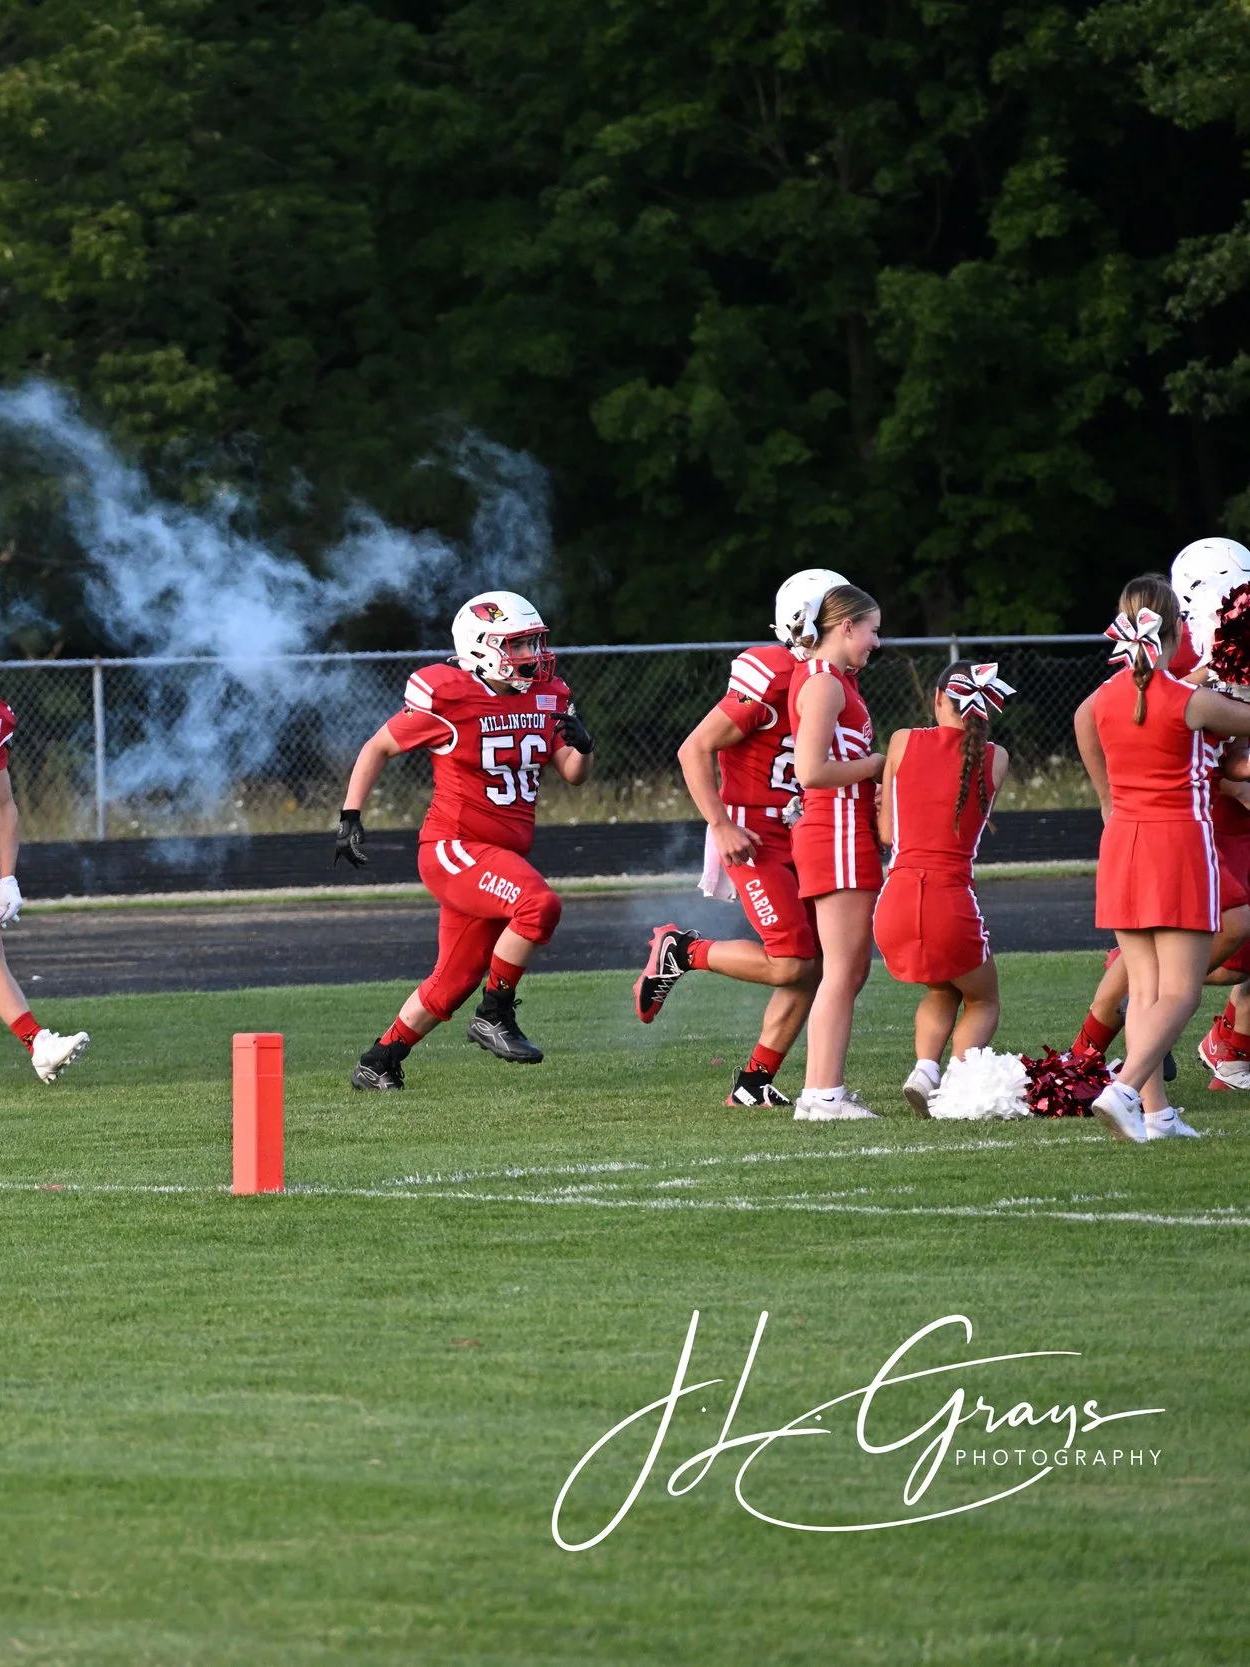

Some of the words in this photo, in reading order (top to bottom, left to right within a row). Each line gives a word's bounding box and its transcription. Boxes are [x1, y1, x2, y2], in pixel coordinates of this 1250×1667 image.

[479, 713, 546, 733] MILLINGTON
[481, 733, 547, 806] 56
[478, 871, 521, 904] CARDS
[745, 879, 779, 927] CARDS
